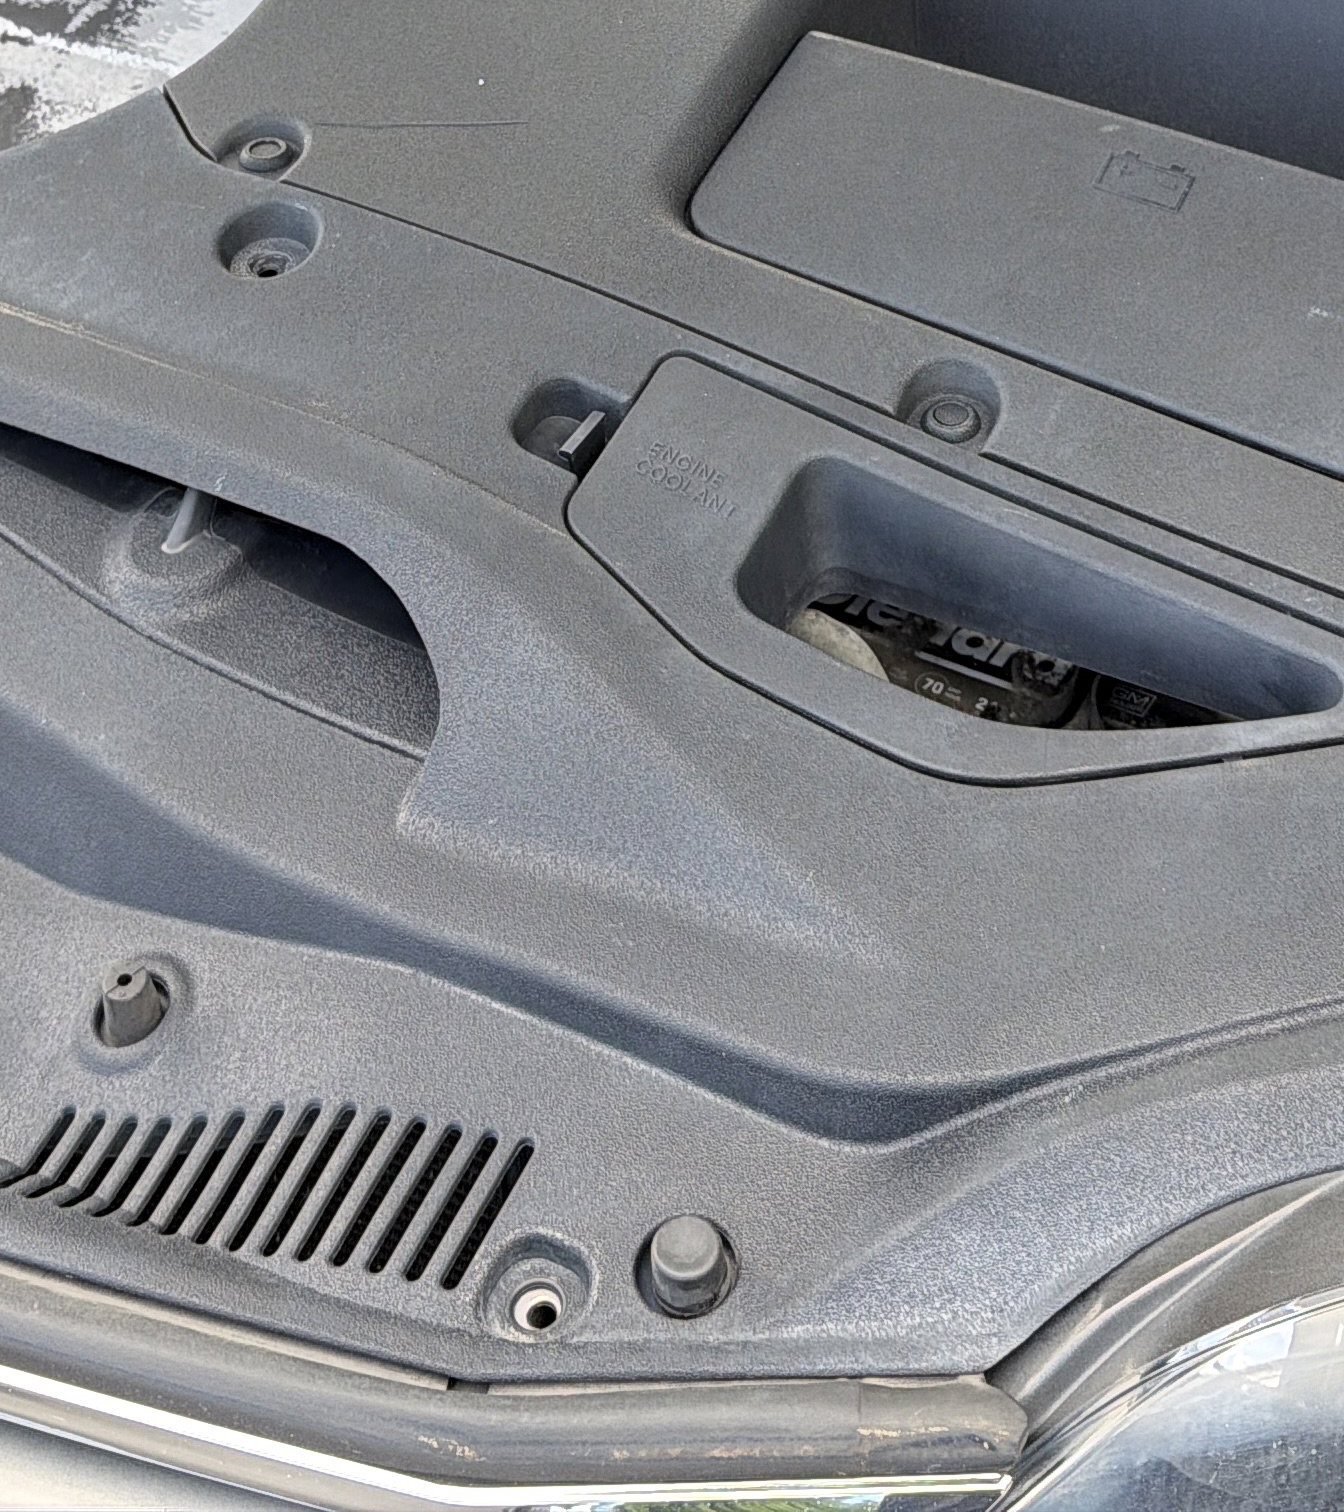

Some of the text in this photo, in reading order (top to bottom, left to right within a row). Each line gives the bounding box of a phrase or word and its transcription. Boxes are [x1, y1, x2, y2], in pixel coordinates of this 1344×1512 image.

[648, 441, 728, 489] ENGINE
[636, 459, 740, 521] COOLANT
[922, 677, 945, 695] 70
